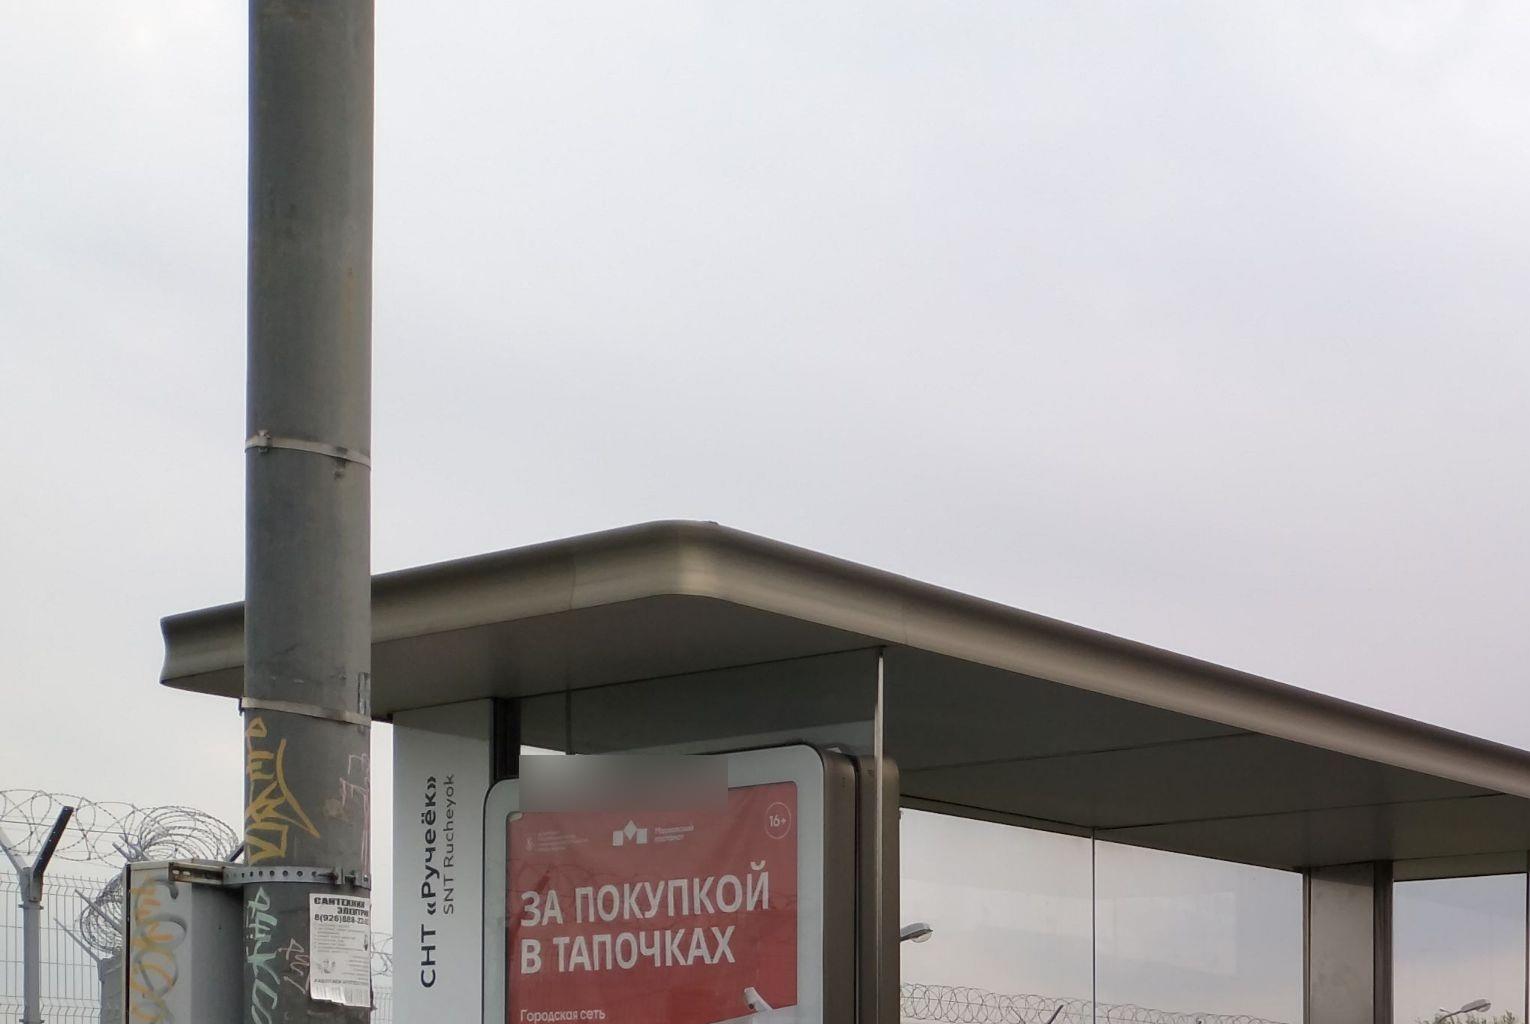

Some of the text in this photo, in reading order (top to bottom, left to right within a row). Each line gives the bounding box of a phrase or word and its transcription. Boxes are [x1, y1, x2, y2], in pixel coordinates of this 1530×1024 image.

[443, 774, 457, 915] SNT Rucheyok
[769, 814, 787, 828] 16+
[420, 776, 440, 988] СНТ «Ручеёк»
[520, 860, 770, 927] ЗА ПОКУПКОЙ
[520, 925, 736, 975] В ТАПОЧКАХ
[520, 1008, 606, 1024] Городская сеть
